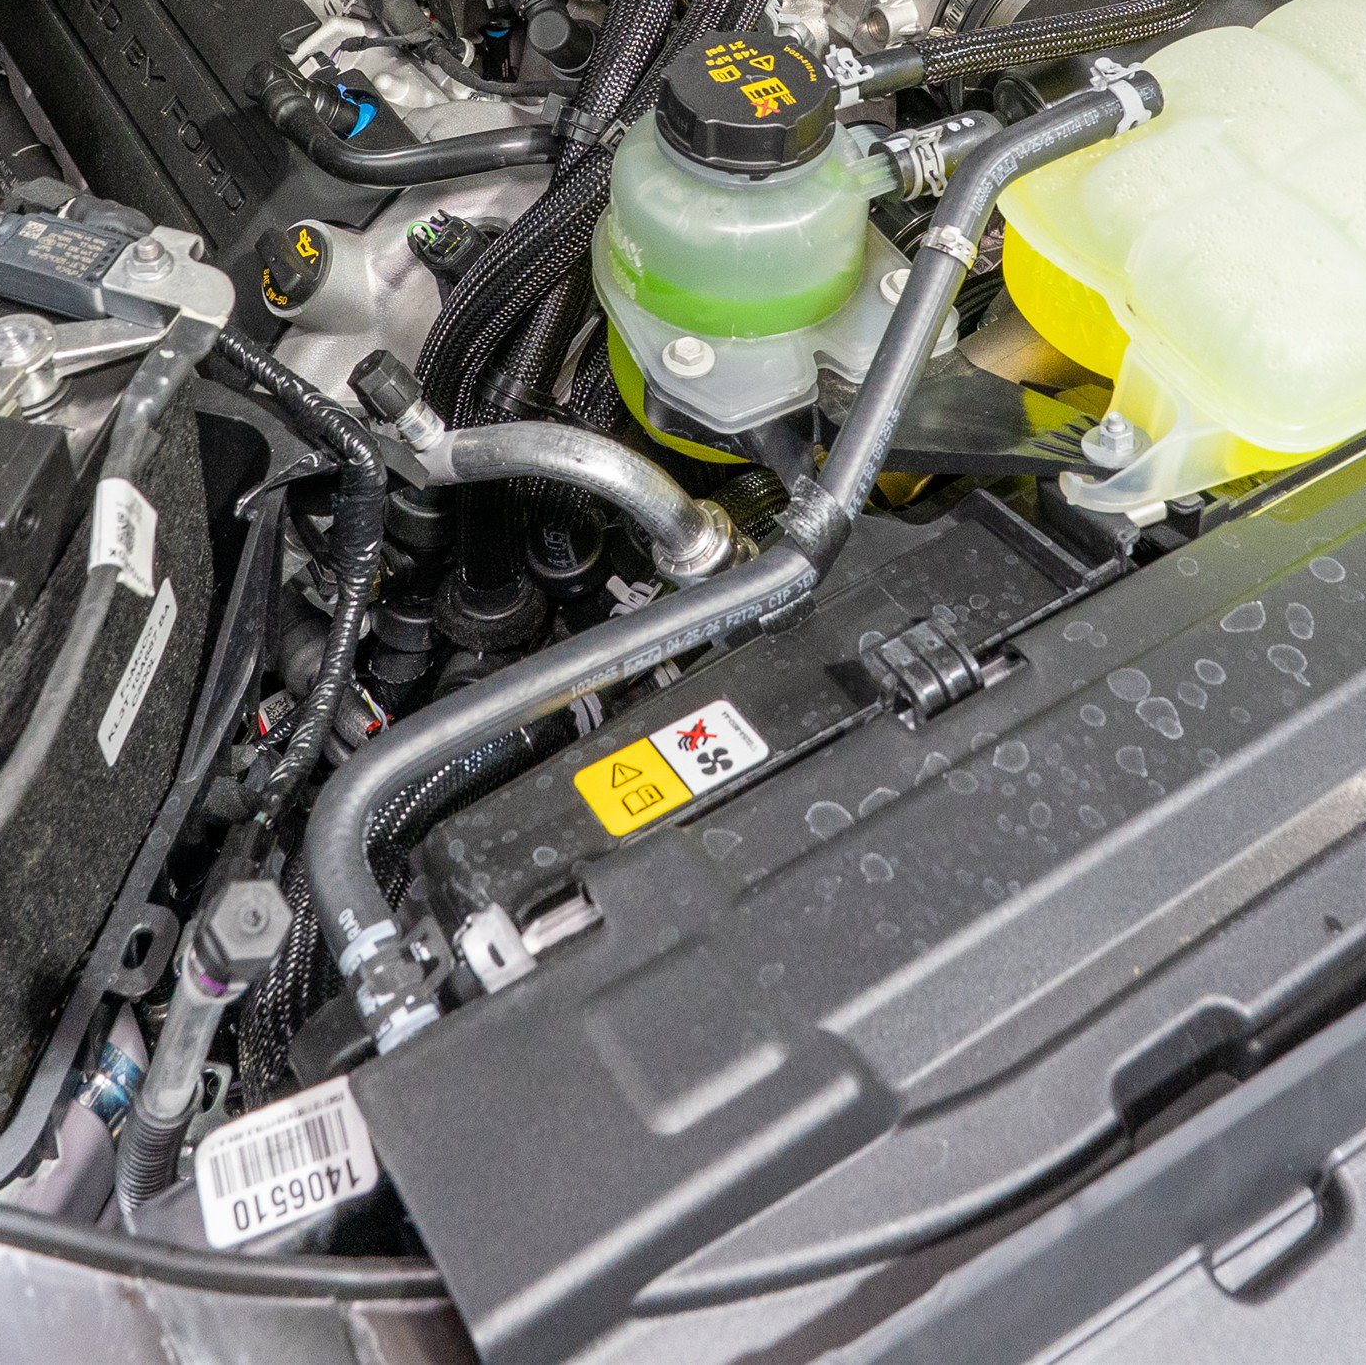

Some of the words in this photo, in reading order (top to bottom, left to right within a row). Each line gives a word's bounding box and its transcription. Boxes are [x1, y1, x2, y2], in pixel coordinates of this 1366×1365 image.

[705, 44, 726, 57] psi
[729, 40, 745, 50] 21
[734, 48, 758, 60] 145
[706, 55, 733, 66] kPa
[120, 35, 166, 86] BY
[161, 94, 246, 215] FORD
[233, 1158, 361, 1231] 1406510
